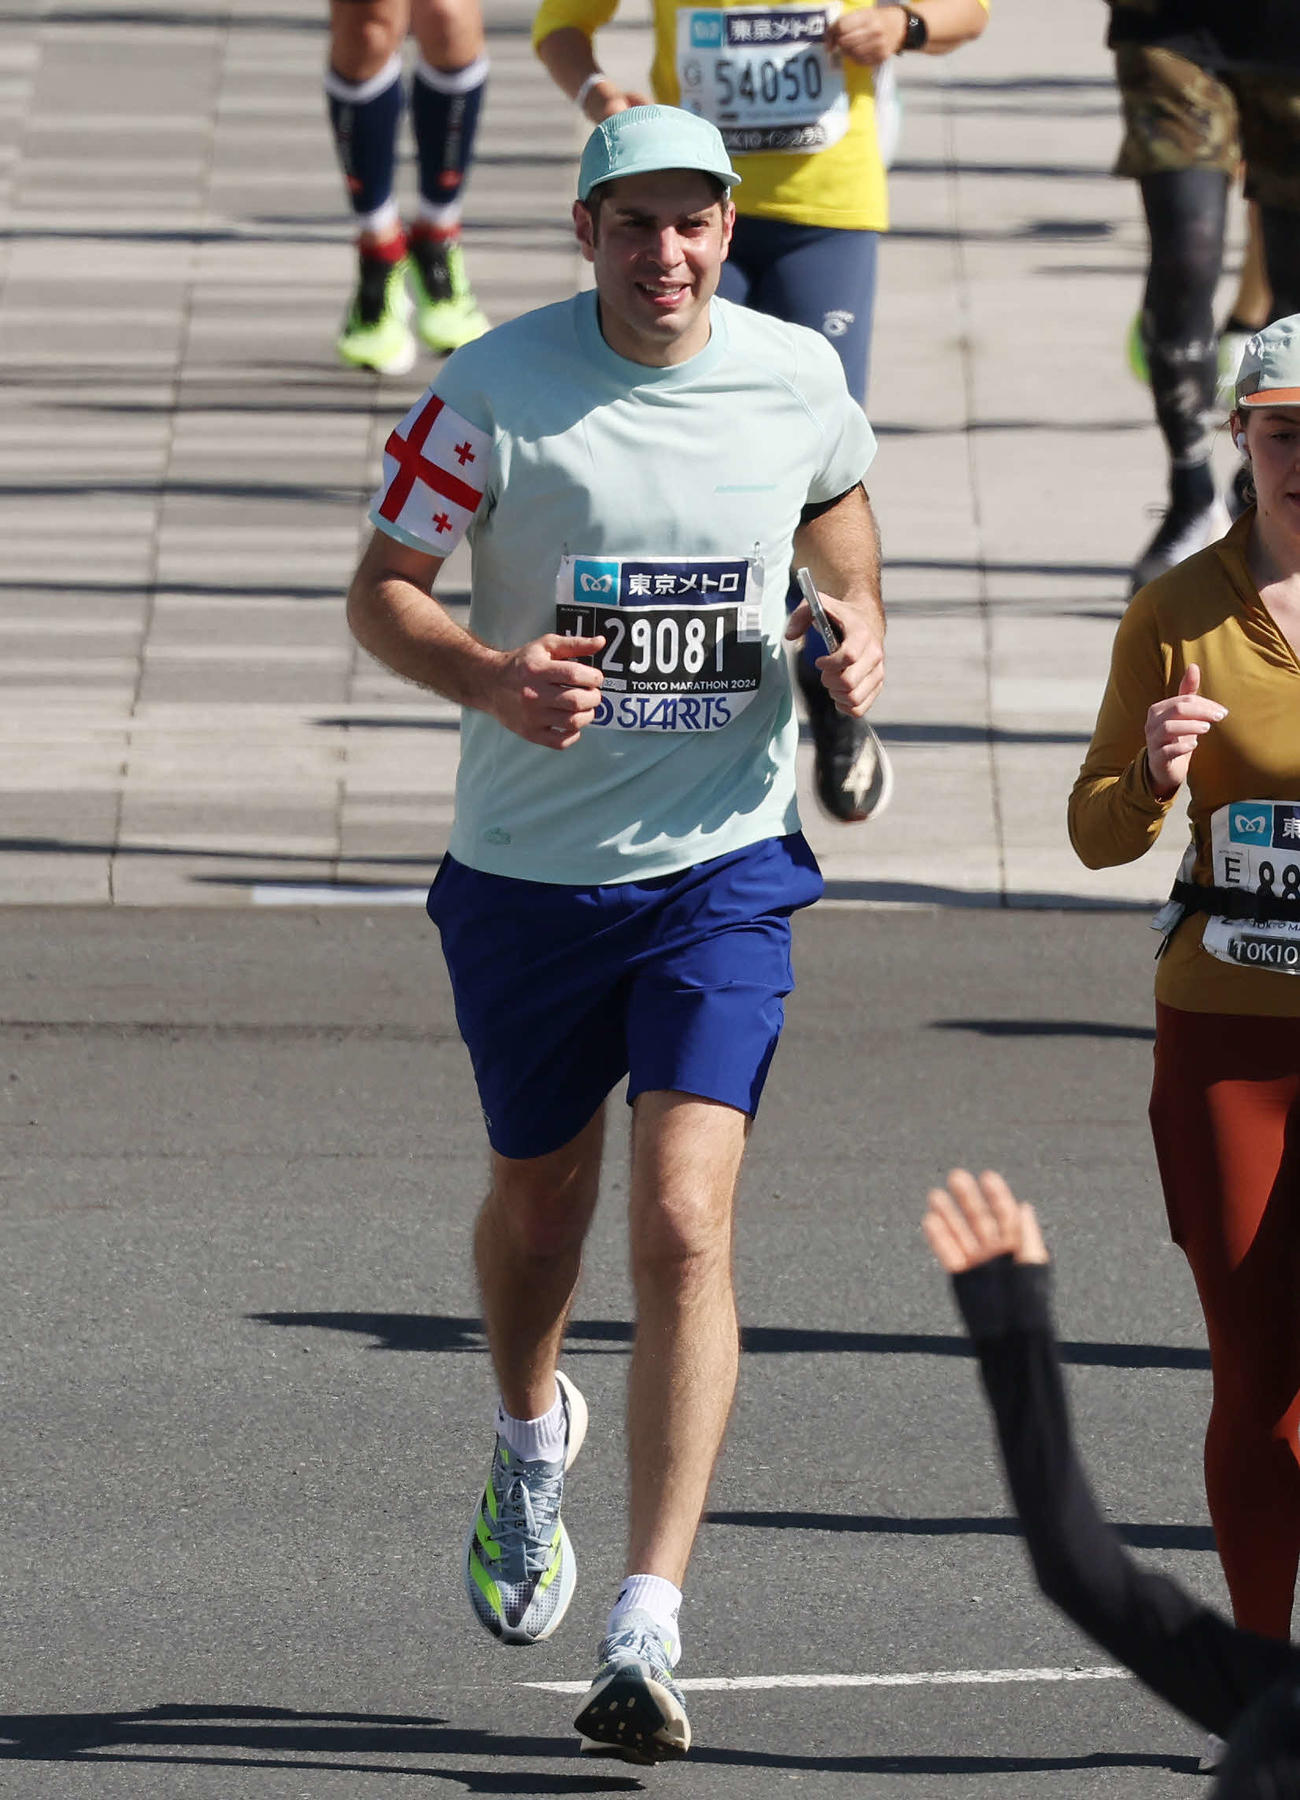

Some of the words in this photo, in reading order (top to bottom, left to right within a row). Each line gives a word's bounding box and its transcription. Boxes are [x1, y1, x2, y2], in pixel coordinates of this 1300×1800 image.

[715, 54, 822, 106] 54050
[628, 573, 740, 596] 東京メトロ
[601, 616, 725, 674] 29081
[632, 681, 668, 691] TOKYO
[670, 681, 729, 691] MARATHON
[731, 679, 756, 689] 2024
[1282, 817, 1300, 839] 東
[1225, 857, 1241, 883] E
[1233, 940, 1299, 965] TOKIO
